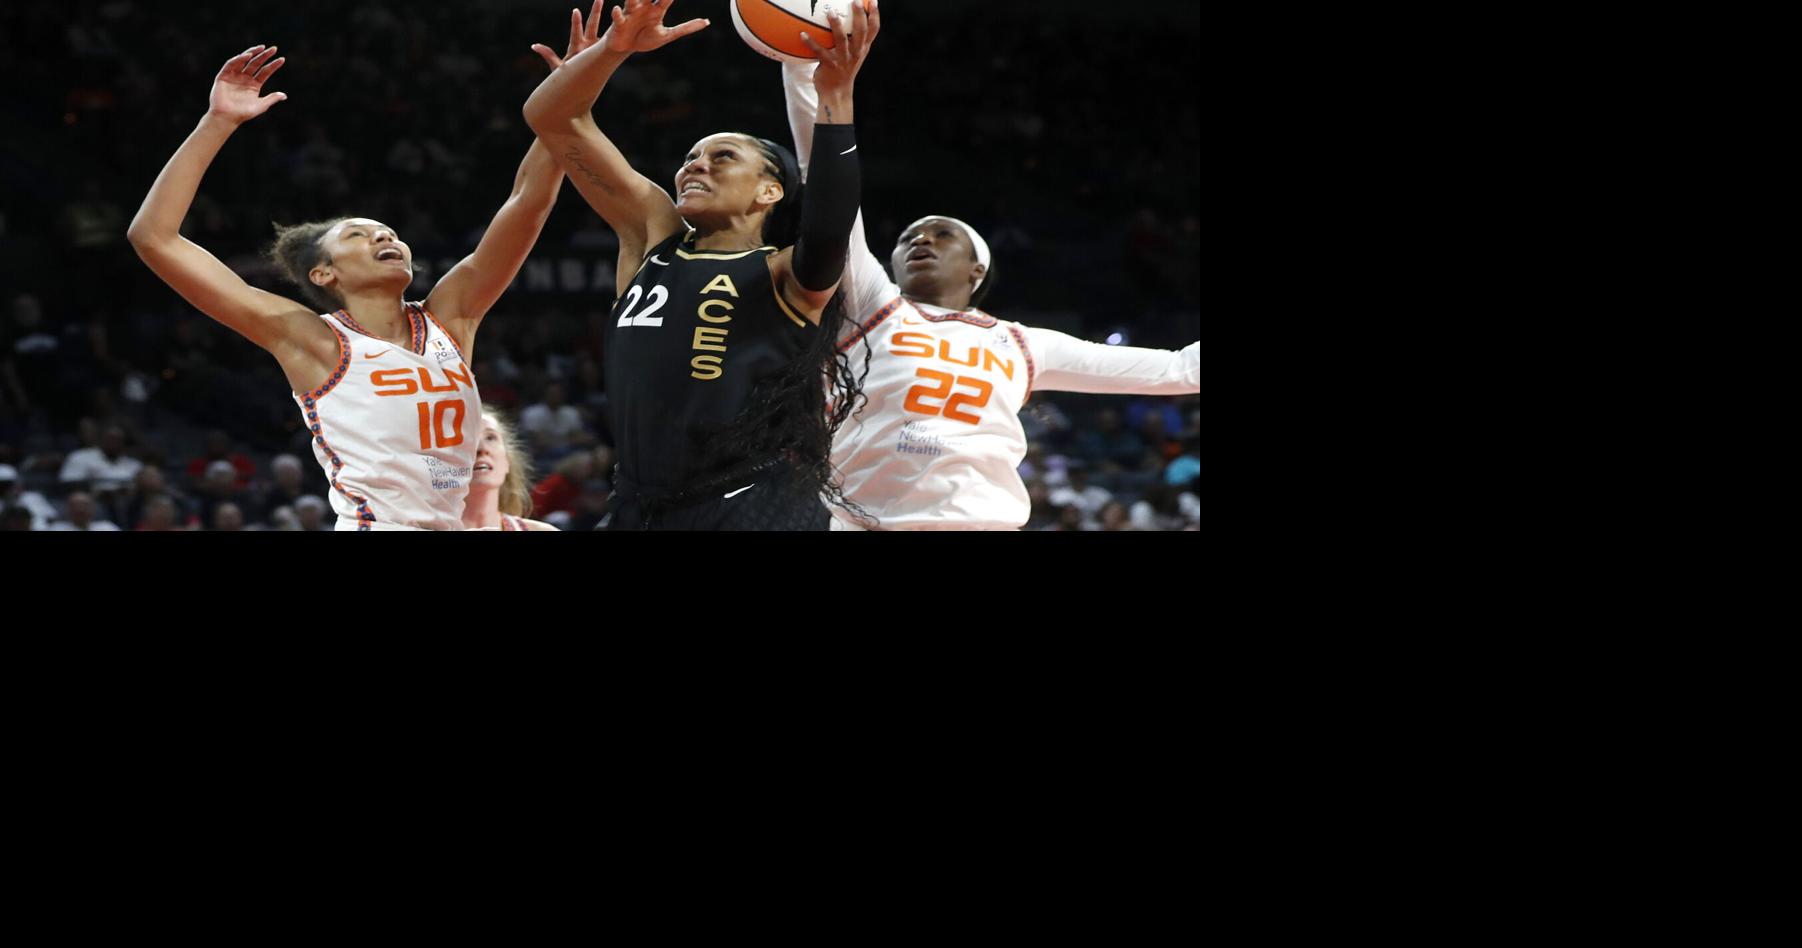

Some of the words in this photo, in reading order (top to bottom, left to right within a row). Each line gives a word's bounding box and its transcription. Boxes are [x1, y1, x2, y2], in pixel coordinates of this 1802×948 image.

[511, 259, 614, 291] NBA
[617, 284, 669, 328] 22
[690, 274, 739, 381] ACES
[889, 331, 1015, 382] SUN
[903, 367, 994, 426] 22
[417, 399, 466, 450] 10
[896, 442, 942, 457] Health
[432, 478, 460, 490] Health
